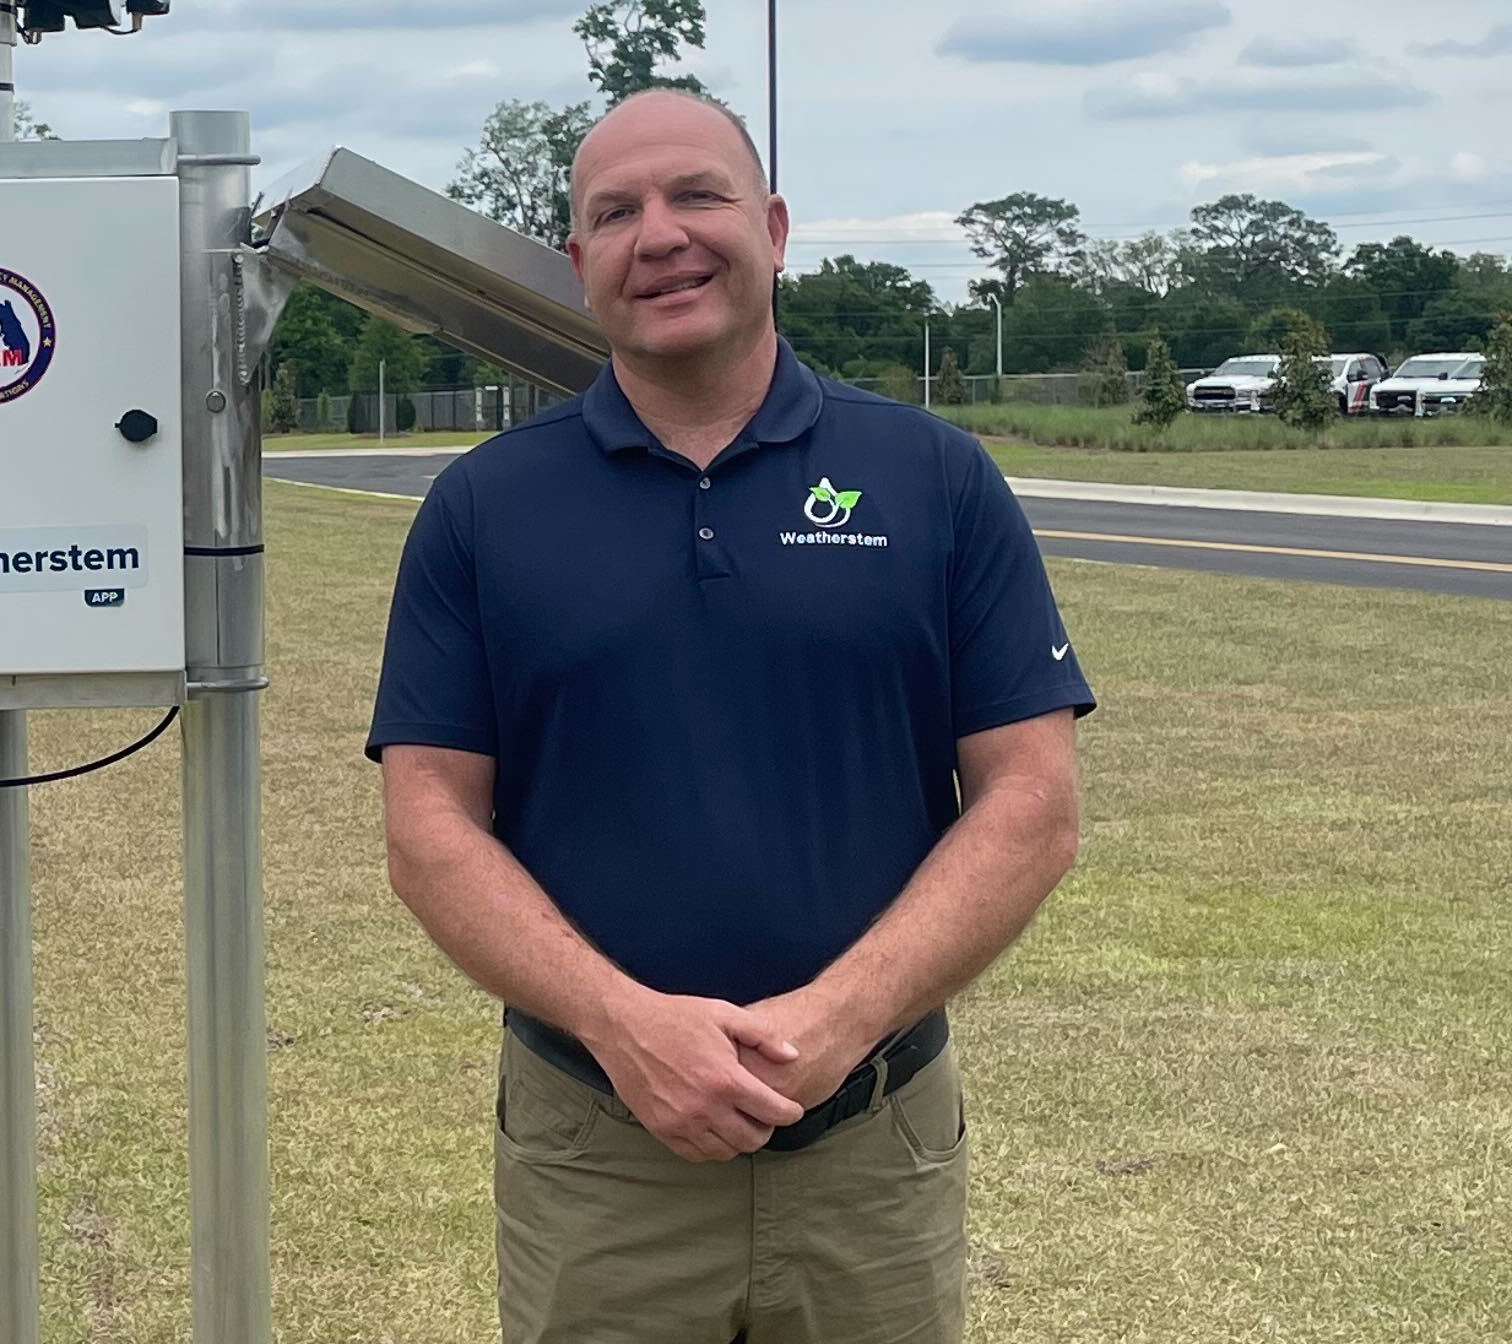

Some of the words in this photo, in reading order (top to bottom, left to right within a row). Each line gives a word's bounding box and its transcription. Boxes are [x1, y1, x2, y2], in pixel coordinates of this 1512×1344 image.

[8, 276, 51, 329] MANAGEMENT
[779, 531, 888, 547] Weatherstem
[91, 591, 119, 603] APP
